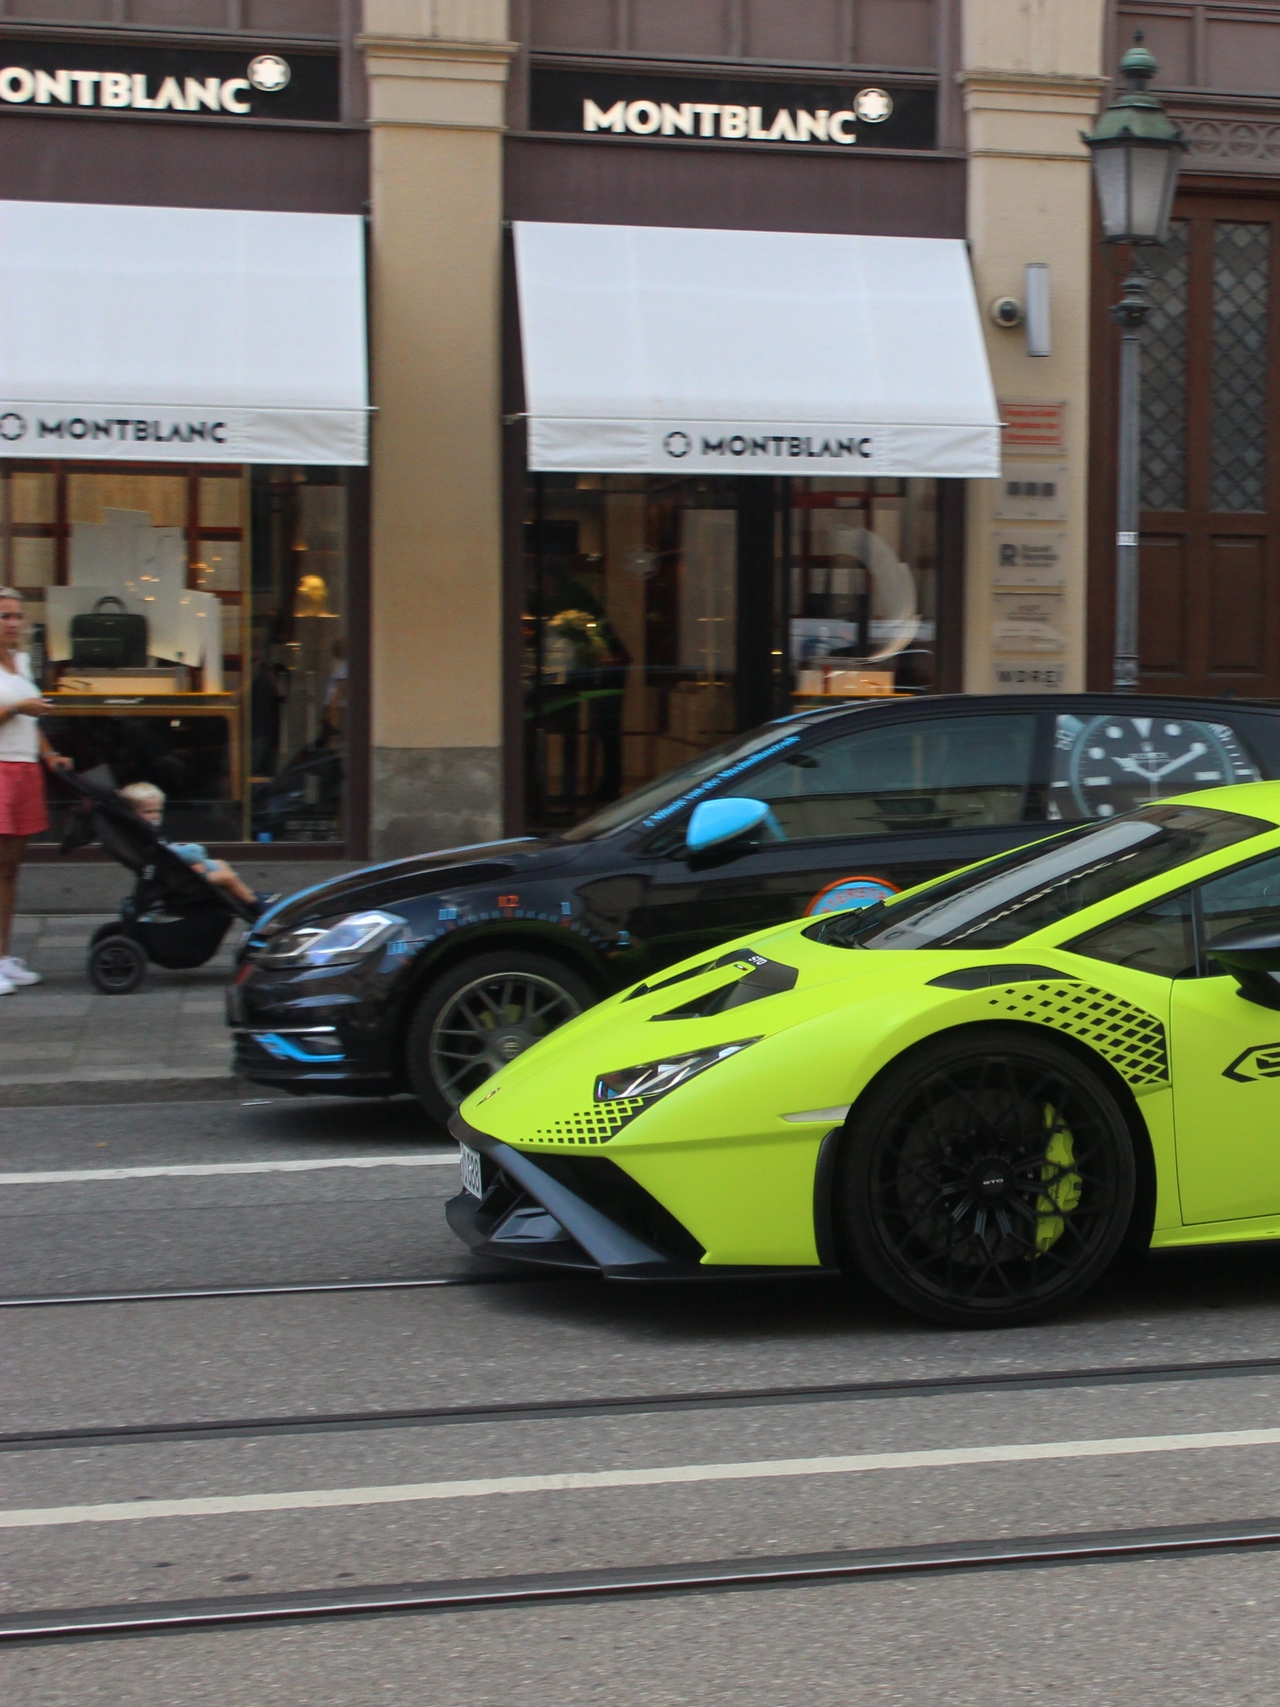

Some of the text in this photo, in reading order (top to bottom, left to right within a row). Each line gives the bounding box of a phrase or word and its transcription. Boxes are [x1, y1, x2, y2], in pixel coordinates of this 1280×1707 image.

[583, 98, 857, 144] MONTBLANC
[37, 417, 227, 444] MONTBLANC
[700, 435, 873, 458] MONTBLANC
[617, 931, 631, 946] 2
